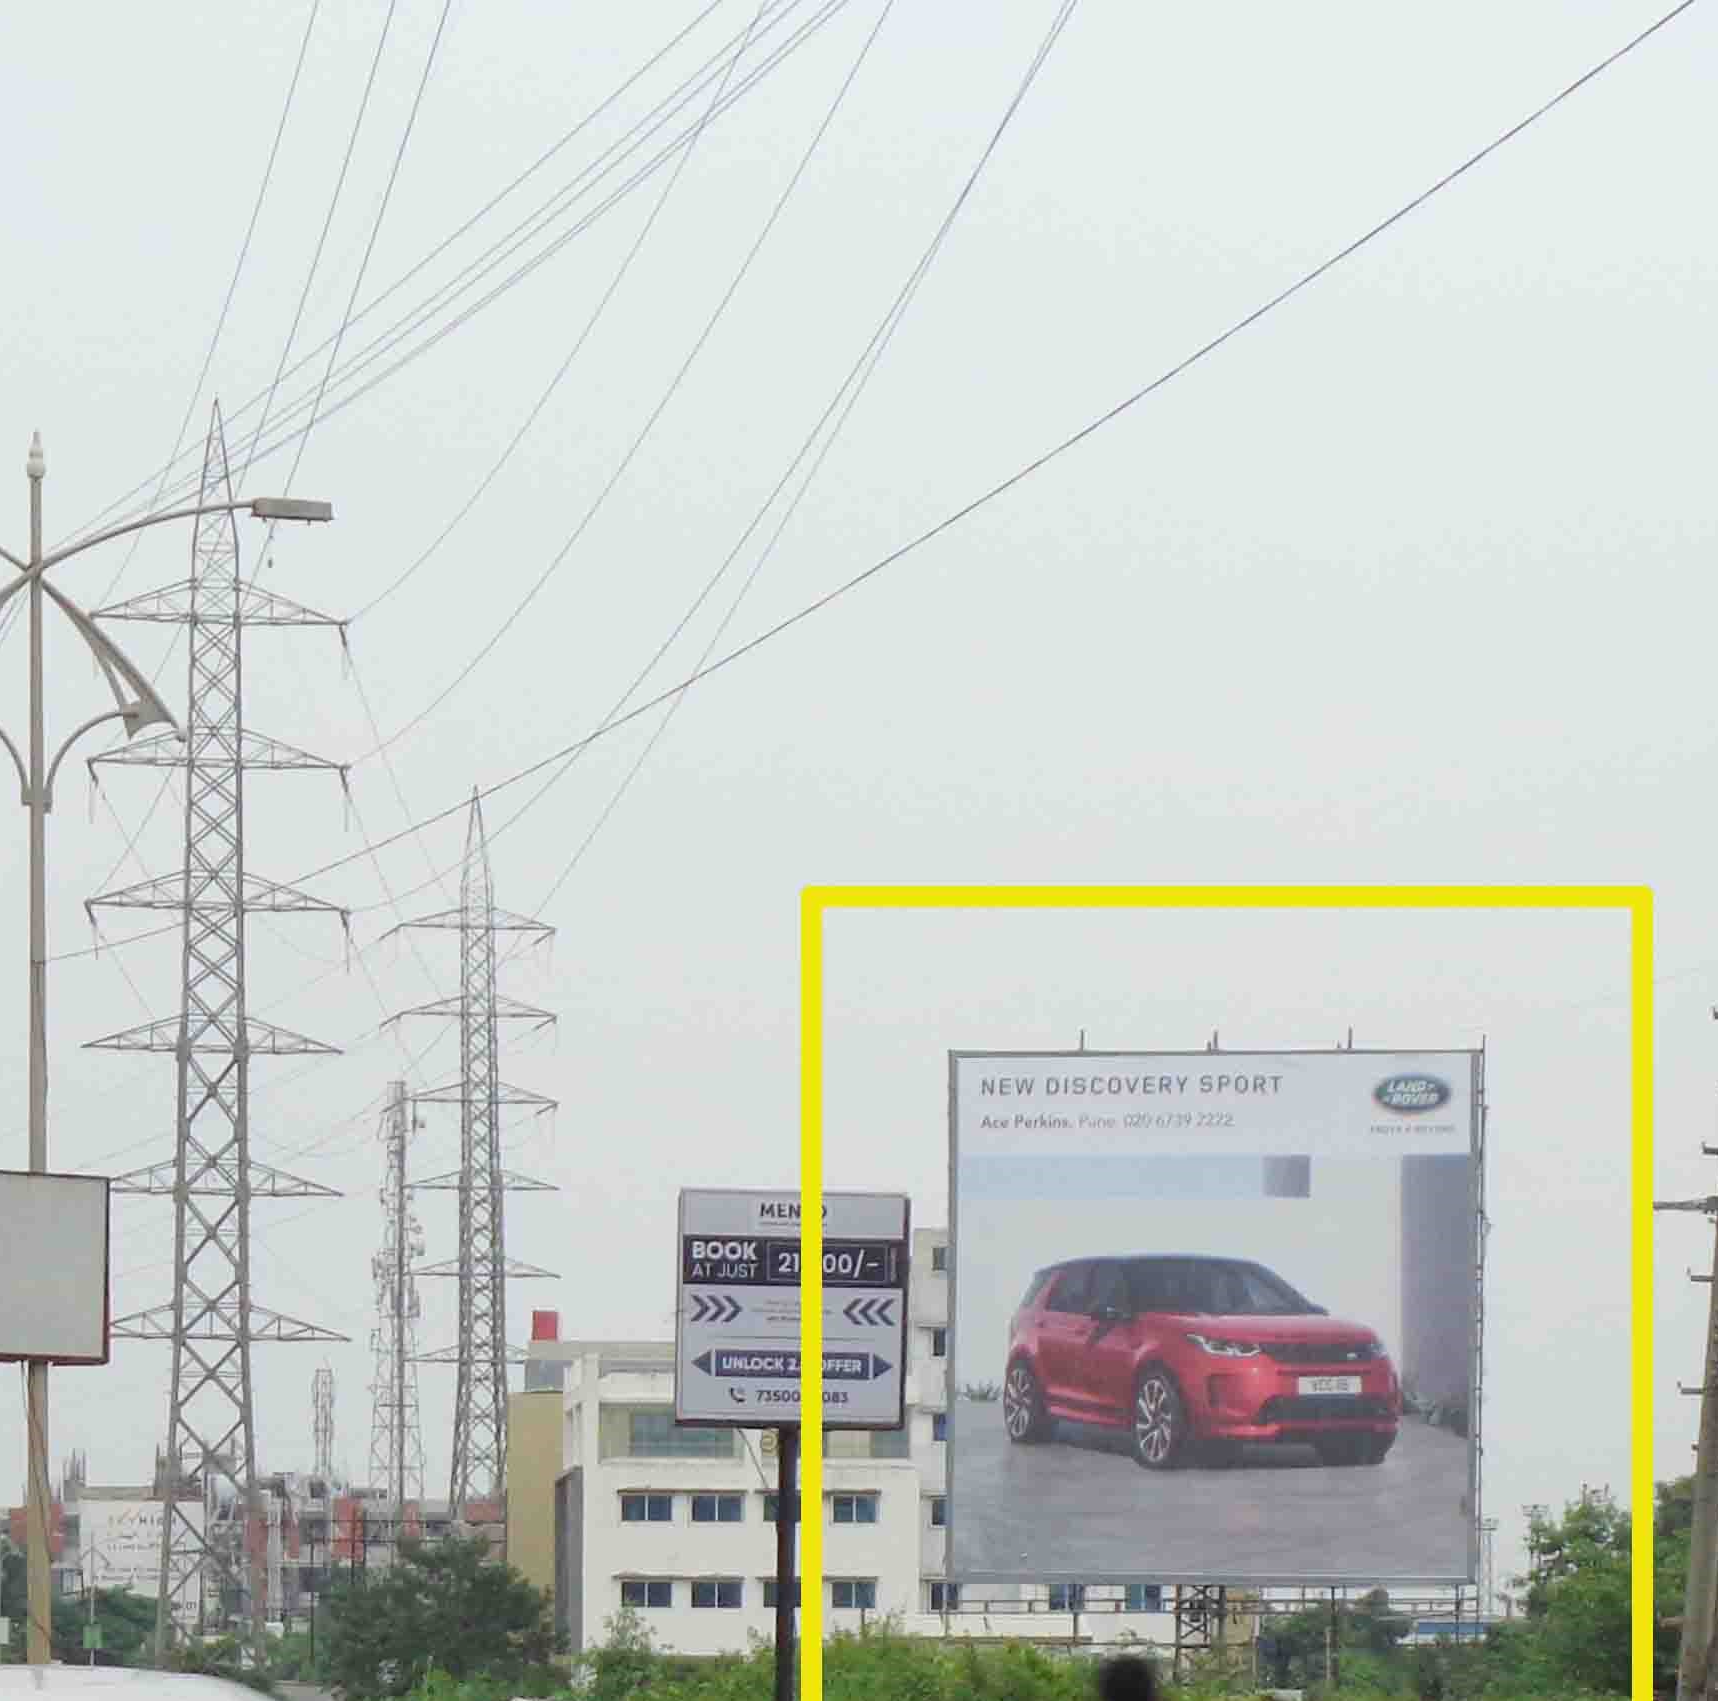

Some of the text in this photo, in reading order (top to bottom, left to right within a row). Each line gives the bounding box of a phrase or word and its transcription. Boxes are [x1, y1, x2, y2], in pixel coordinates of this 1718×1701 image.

[980, 1074, 1284, 1096] NEW DISCOVERY SPORT
[1387, 1079, 1428, 1093] LAND
[1391, 1092, 1440, 1105] ROVER
[980, 1114, 1010, 1129] Ace
[759, 1202, 827, 1219] MEN
[691, 1240, 757, 1261] BOOK
[691, 1263, 759, 1279] AT JUST
[777, 1249, 879, 1278] 2100/-
[722, 1356, 784, 1370] UNLOCK
